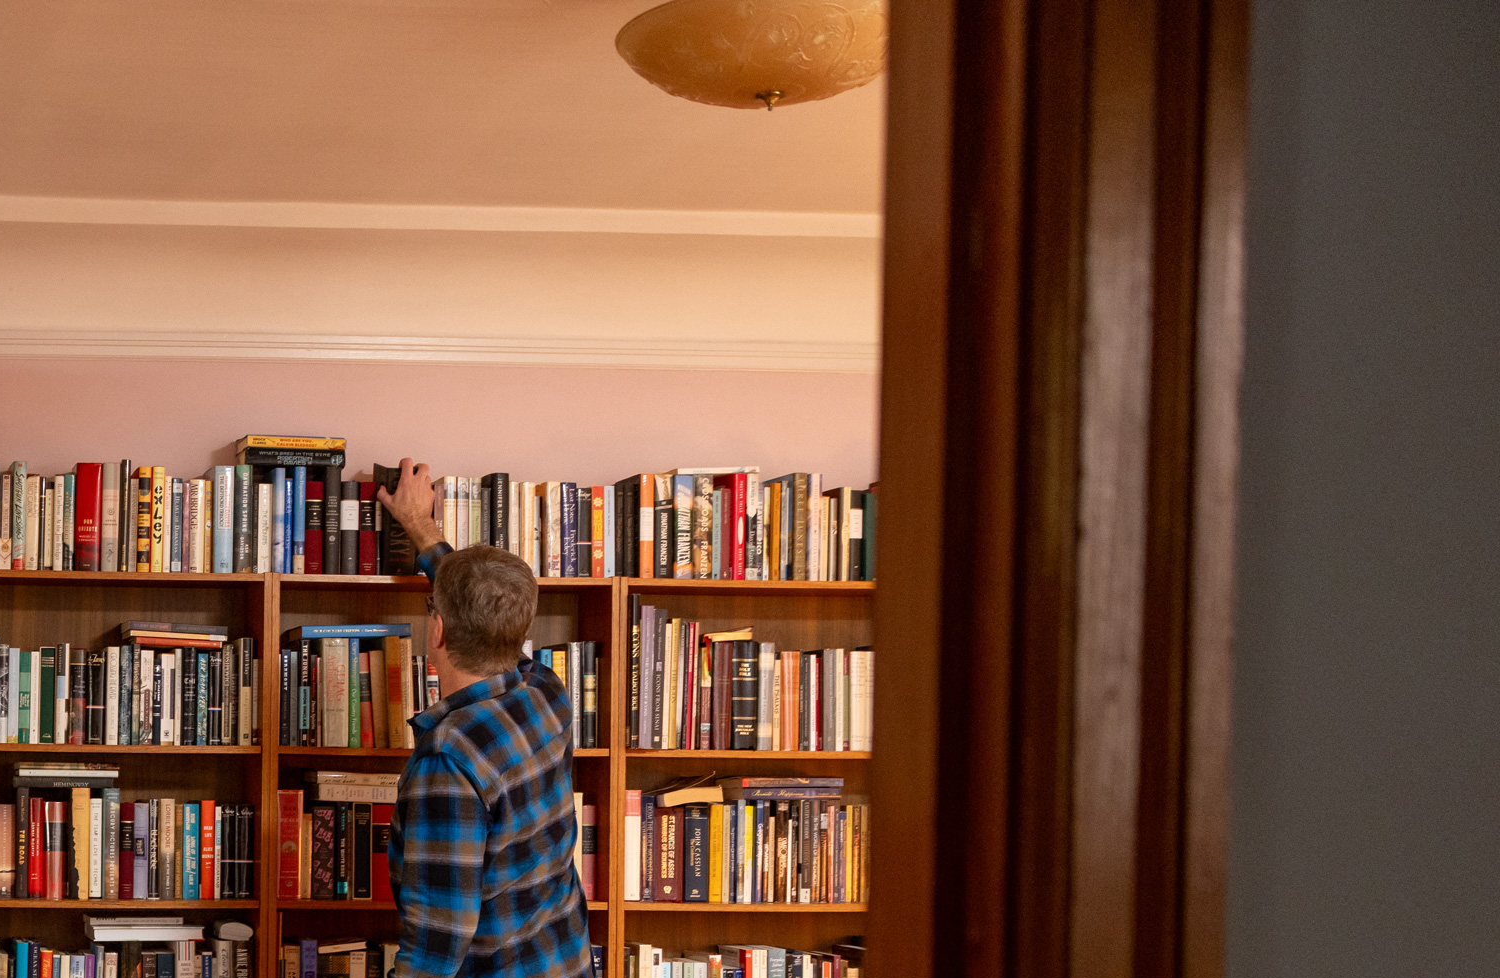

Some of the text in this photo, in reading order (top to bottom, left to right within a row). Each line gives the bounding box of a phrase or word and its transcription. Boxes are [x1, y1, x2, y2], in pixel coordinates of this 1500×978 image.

[15, 471, 24, 540] SHOTGUN LOVESONGS
[190, 498, 198, 530] BRIDGE
[796, 479, 805, 555] THREE JUNES
[700, 477, 710, 579] CROSSROADS FRANZEN
[677, 532, 690, 566] FRANZEN
[337, 664, 346, 702] GULAG
[661, 843, 668, 851] OF
[668, 850, 675, 858] OF
[236, 948, 248, 966] ANNIE
